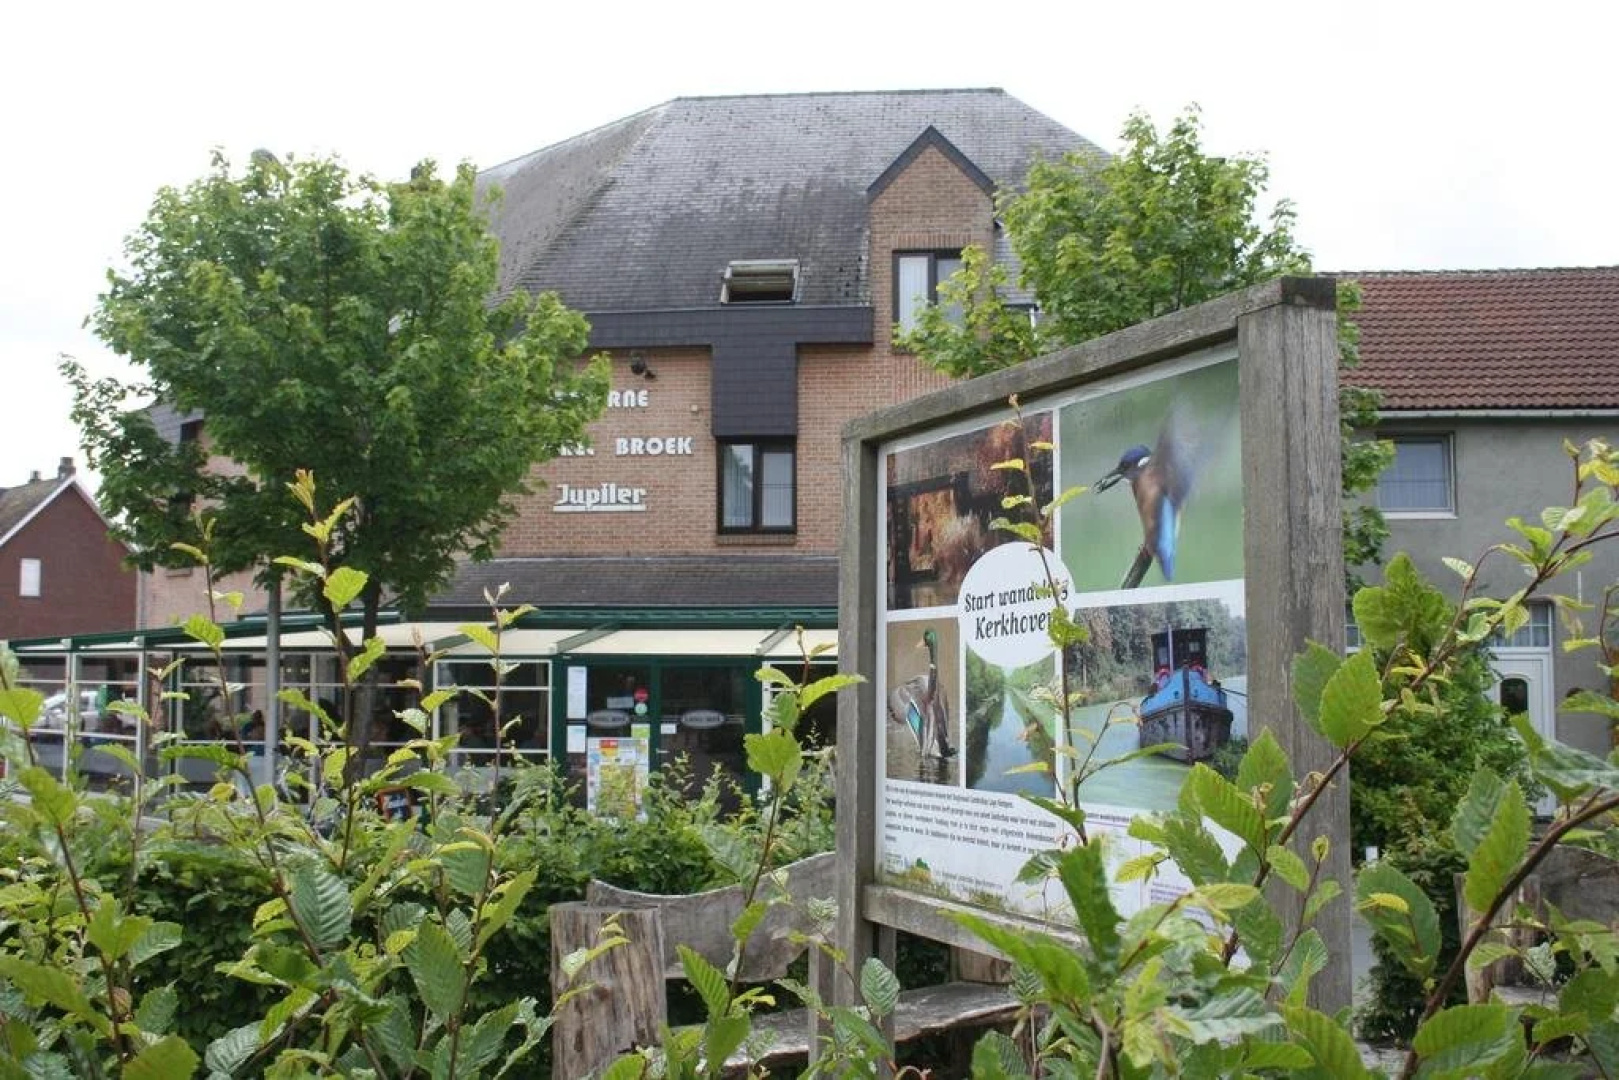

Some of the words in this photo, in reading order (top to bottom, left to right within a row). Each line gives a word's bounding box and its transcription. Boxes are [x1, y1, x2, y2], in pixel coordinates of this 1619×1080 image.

[615, 437, 693, 455] BROEK
[555, 482, 646, 509] Jupiler
[964, 591, 996, 613] Start
